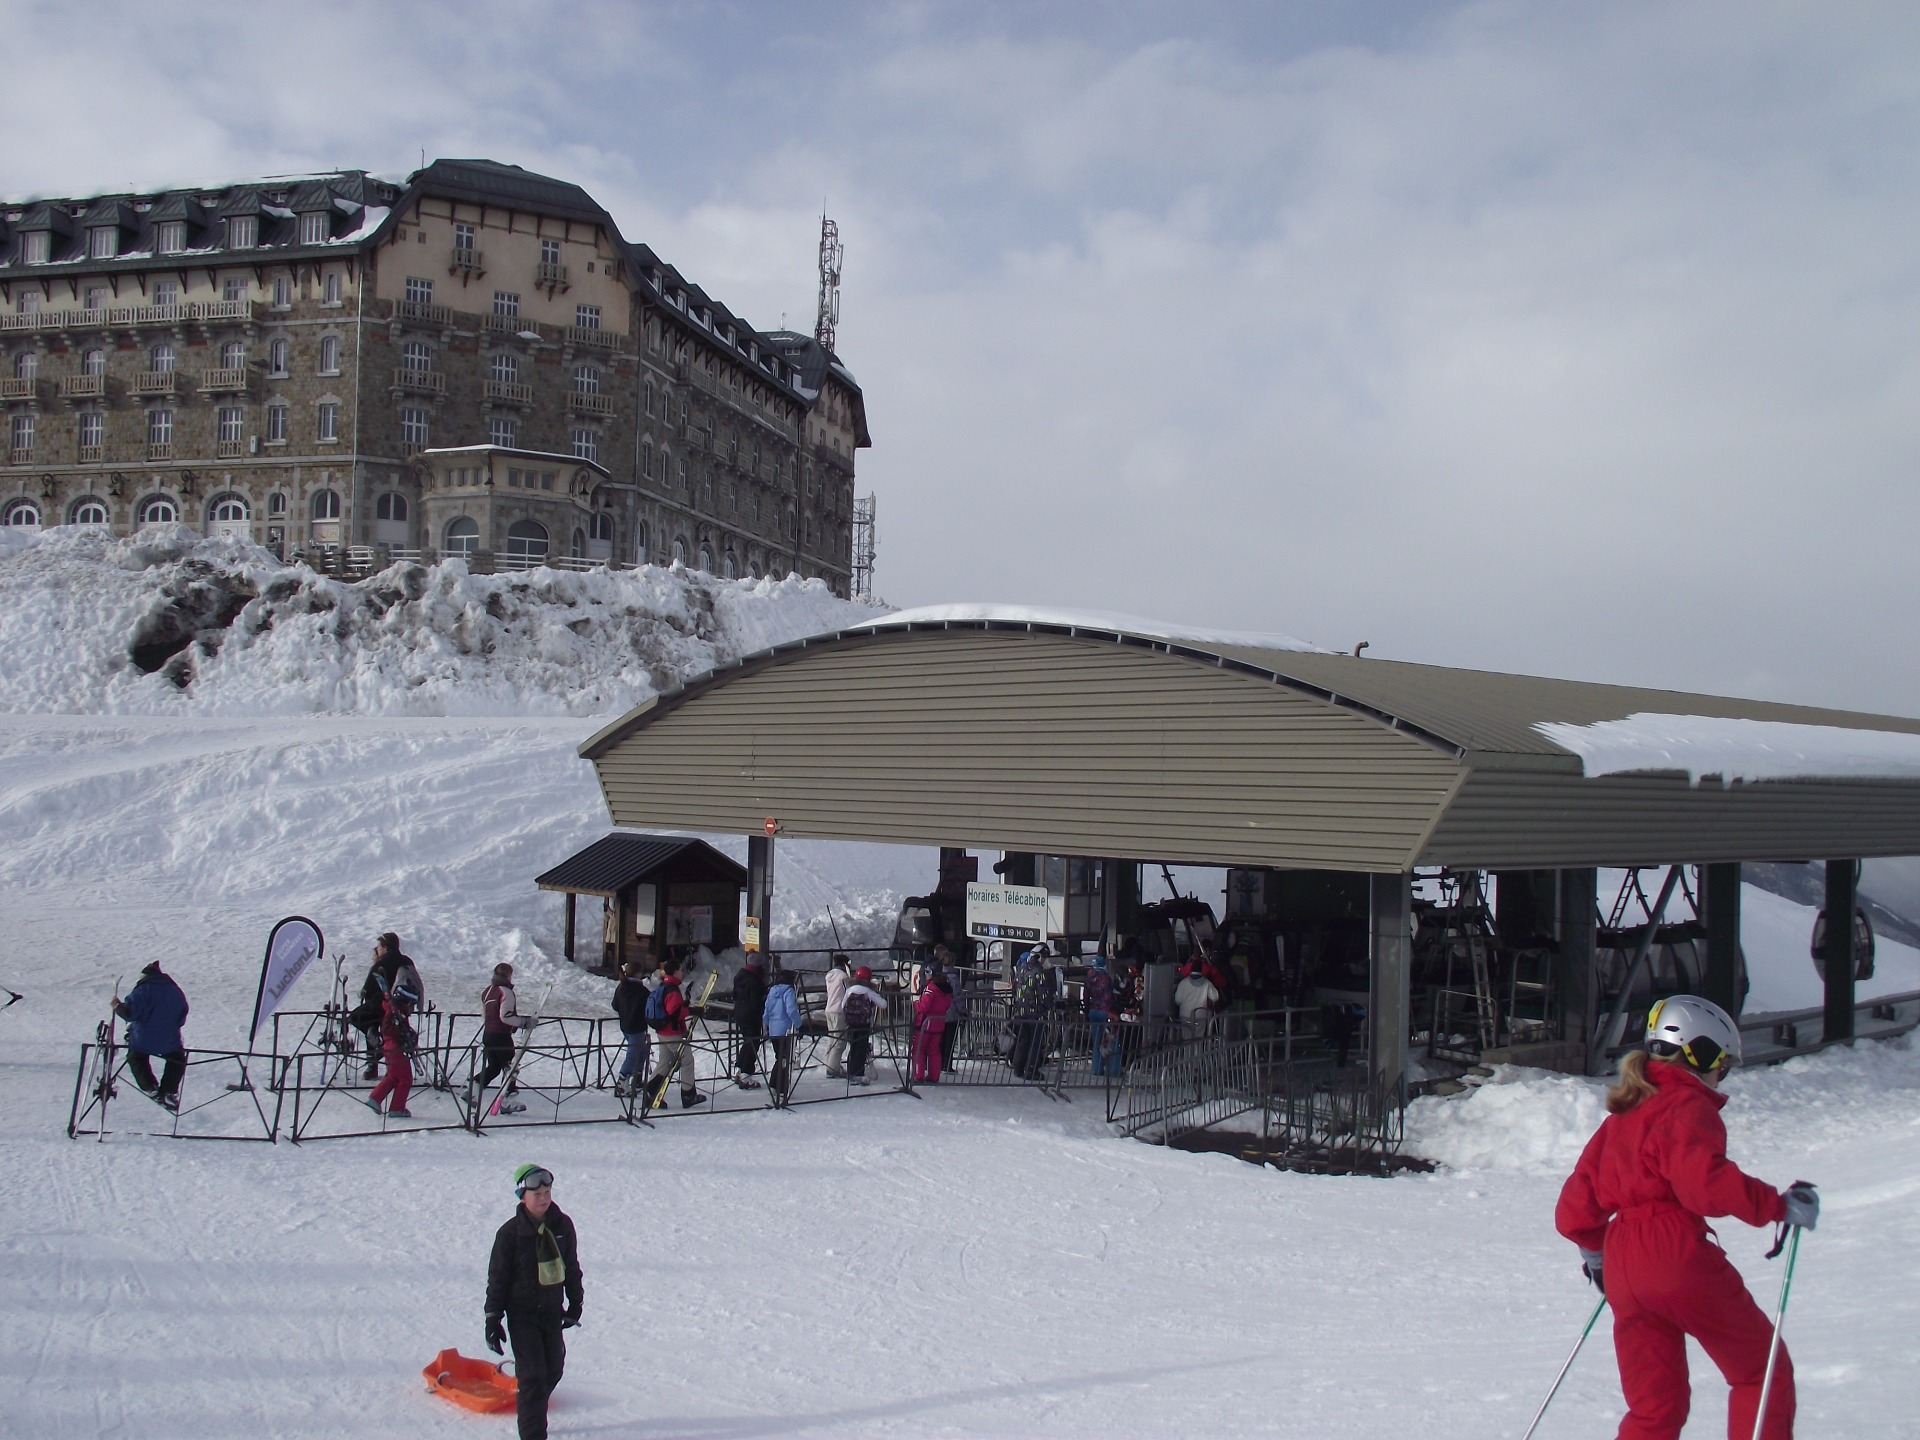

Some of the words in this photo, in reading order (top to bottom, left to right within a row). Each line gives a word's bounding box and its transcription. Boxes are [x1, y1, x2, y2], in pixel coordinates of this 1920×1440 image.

[968, 887, 1000, 903] Horaires
[1004, 890, 1046, 907] Télécabine
[989, 926, 999, 936] 30
[1007, 928, 1015, 937] 19
[1016, 929, 1022, 937] H
[268, 952, 309, 999] Luchon
